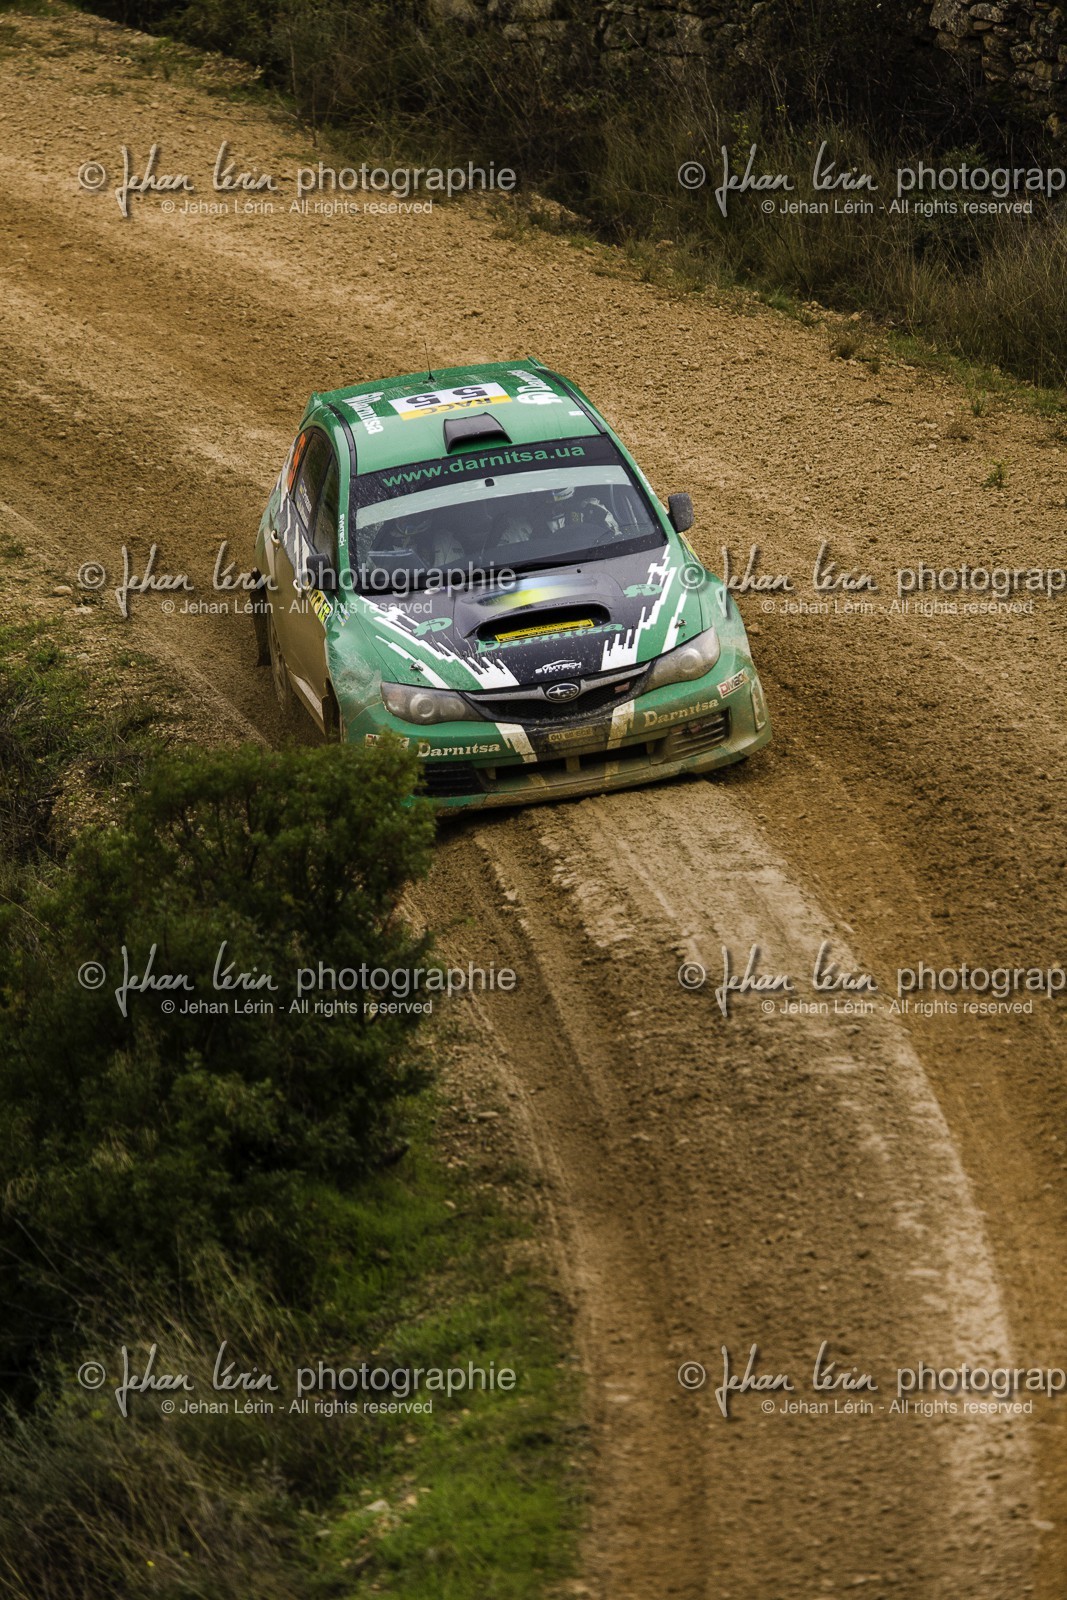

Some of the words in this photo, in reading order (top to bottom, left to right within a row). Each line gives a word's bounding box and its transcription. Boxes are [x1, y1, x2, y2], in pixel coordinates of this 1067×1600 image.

[423, 397, 492, 415] RACC
[382, 444, 585, 488] www.darnitsa.ua
[643, 698, 720, 728] Darnitsa
[416, 741, 501, 758] Darnitsa
